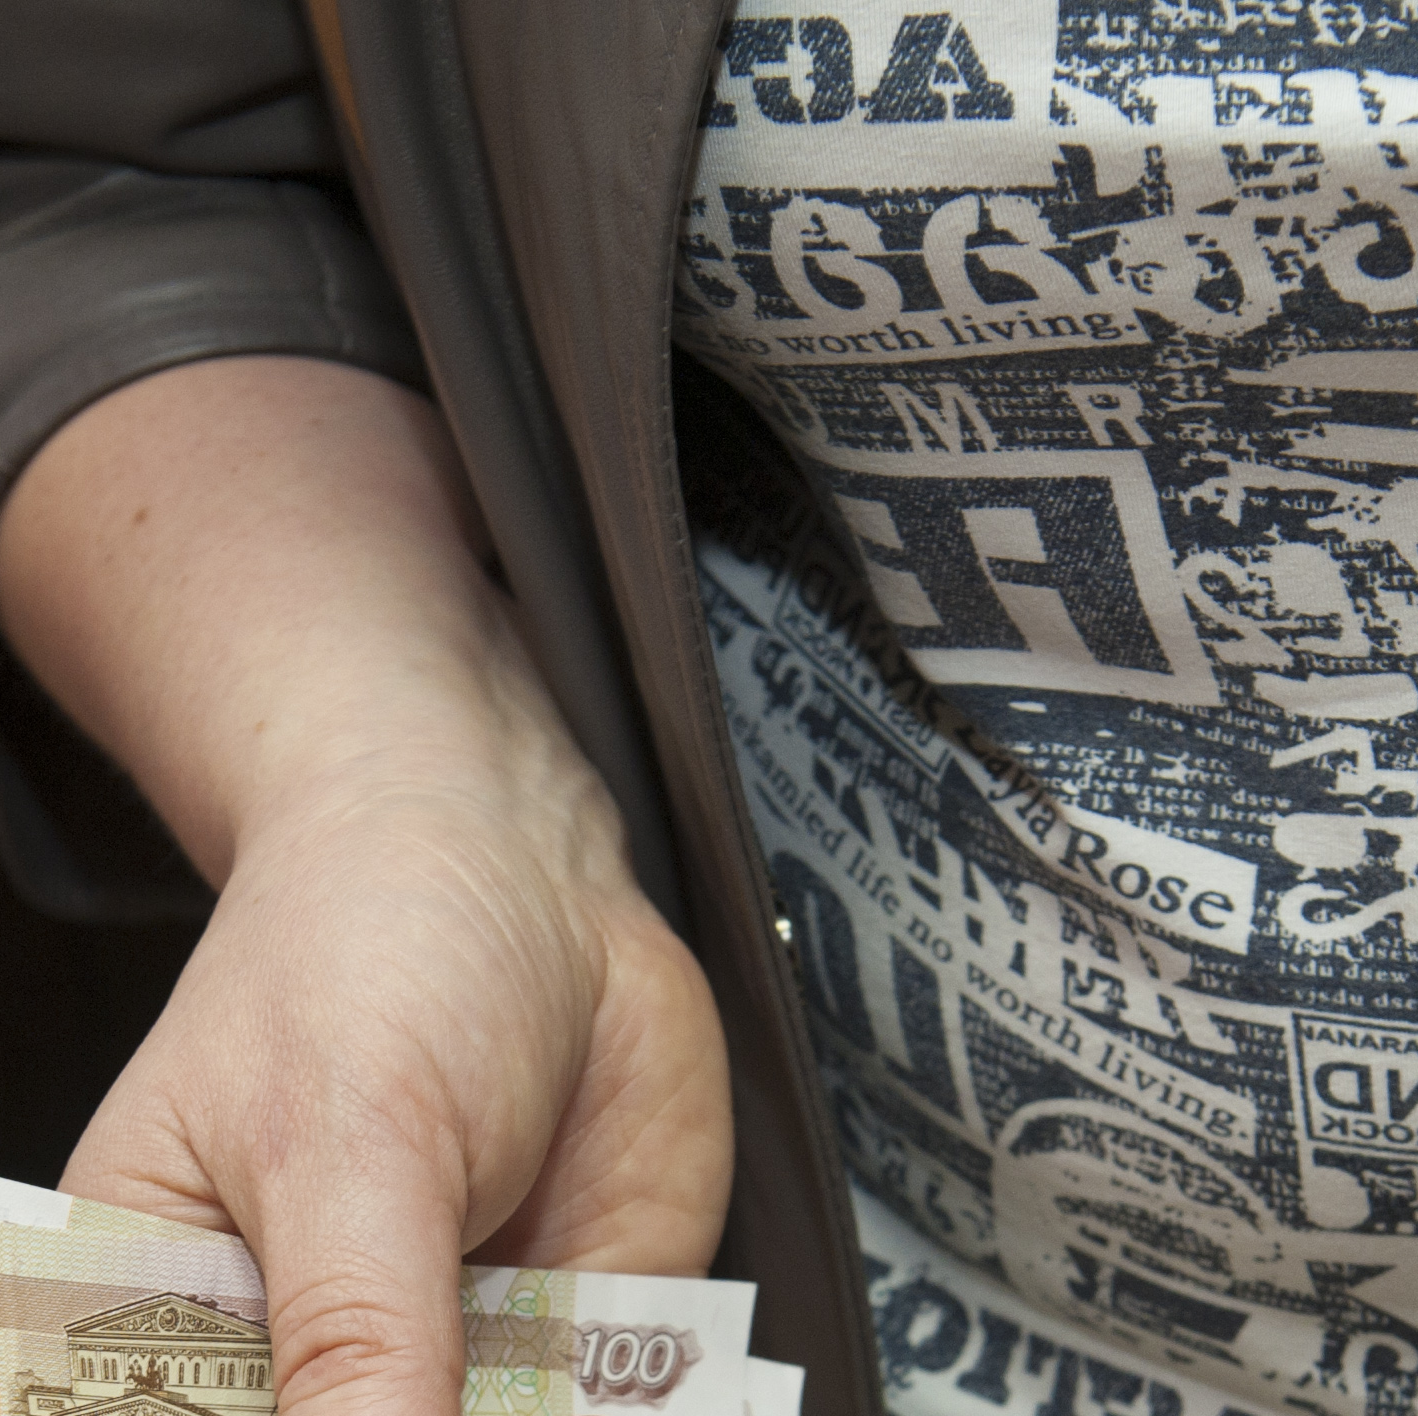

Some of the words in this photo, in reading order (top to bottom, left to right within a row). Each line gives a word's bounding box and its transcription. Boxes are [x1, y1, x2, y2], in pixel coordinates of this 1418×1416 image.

[781, 321, 934, 356] worth
[942, 313, 1138, 347] living.
[1058, 825, 1236, 931] Rose
[907, 914, 955, 963] no
[964, 962, 1082, 1057] worth
[1095, 1043, 1249, 1141] living.
[579, 1327, 678, 1388] 100
